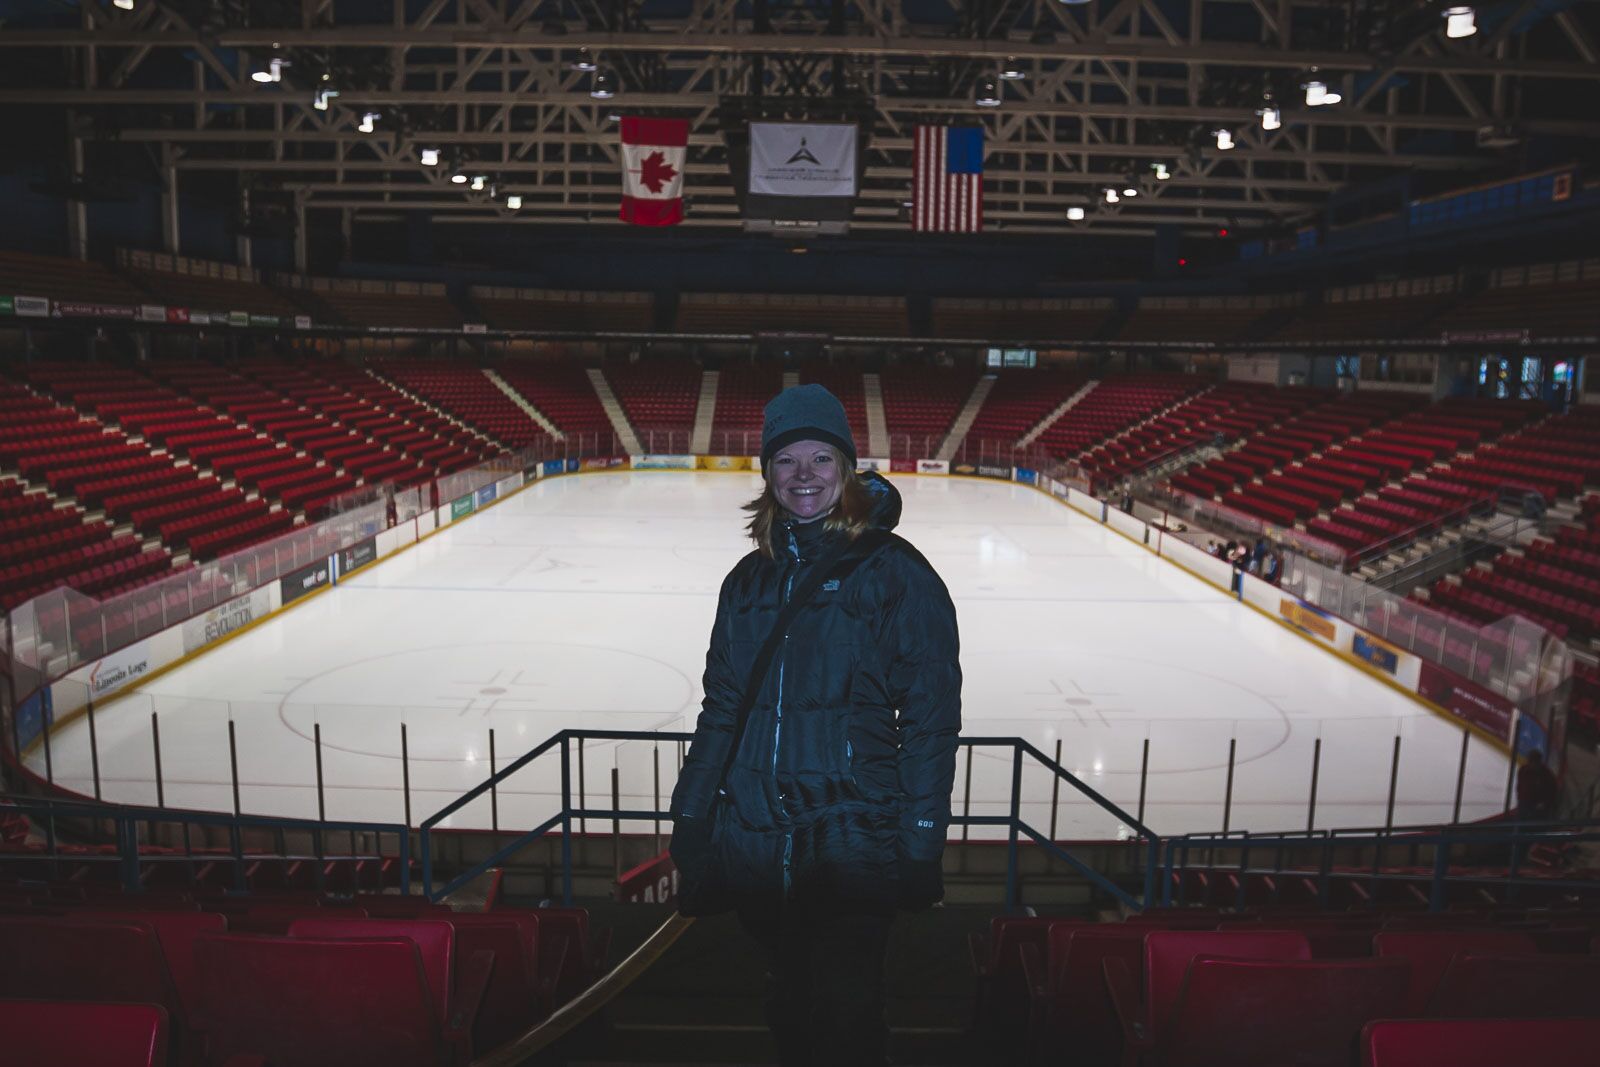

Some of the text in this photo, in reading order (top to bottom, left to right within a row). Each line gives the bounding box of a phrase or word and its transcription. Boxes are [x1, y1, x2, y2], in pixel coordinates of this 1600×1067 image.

[205, 607, 252, 642] REVOLUTION
[128, 660, 147, 675] Logs
[918, 819, 934, 828] 600
